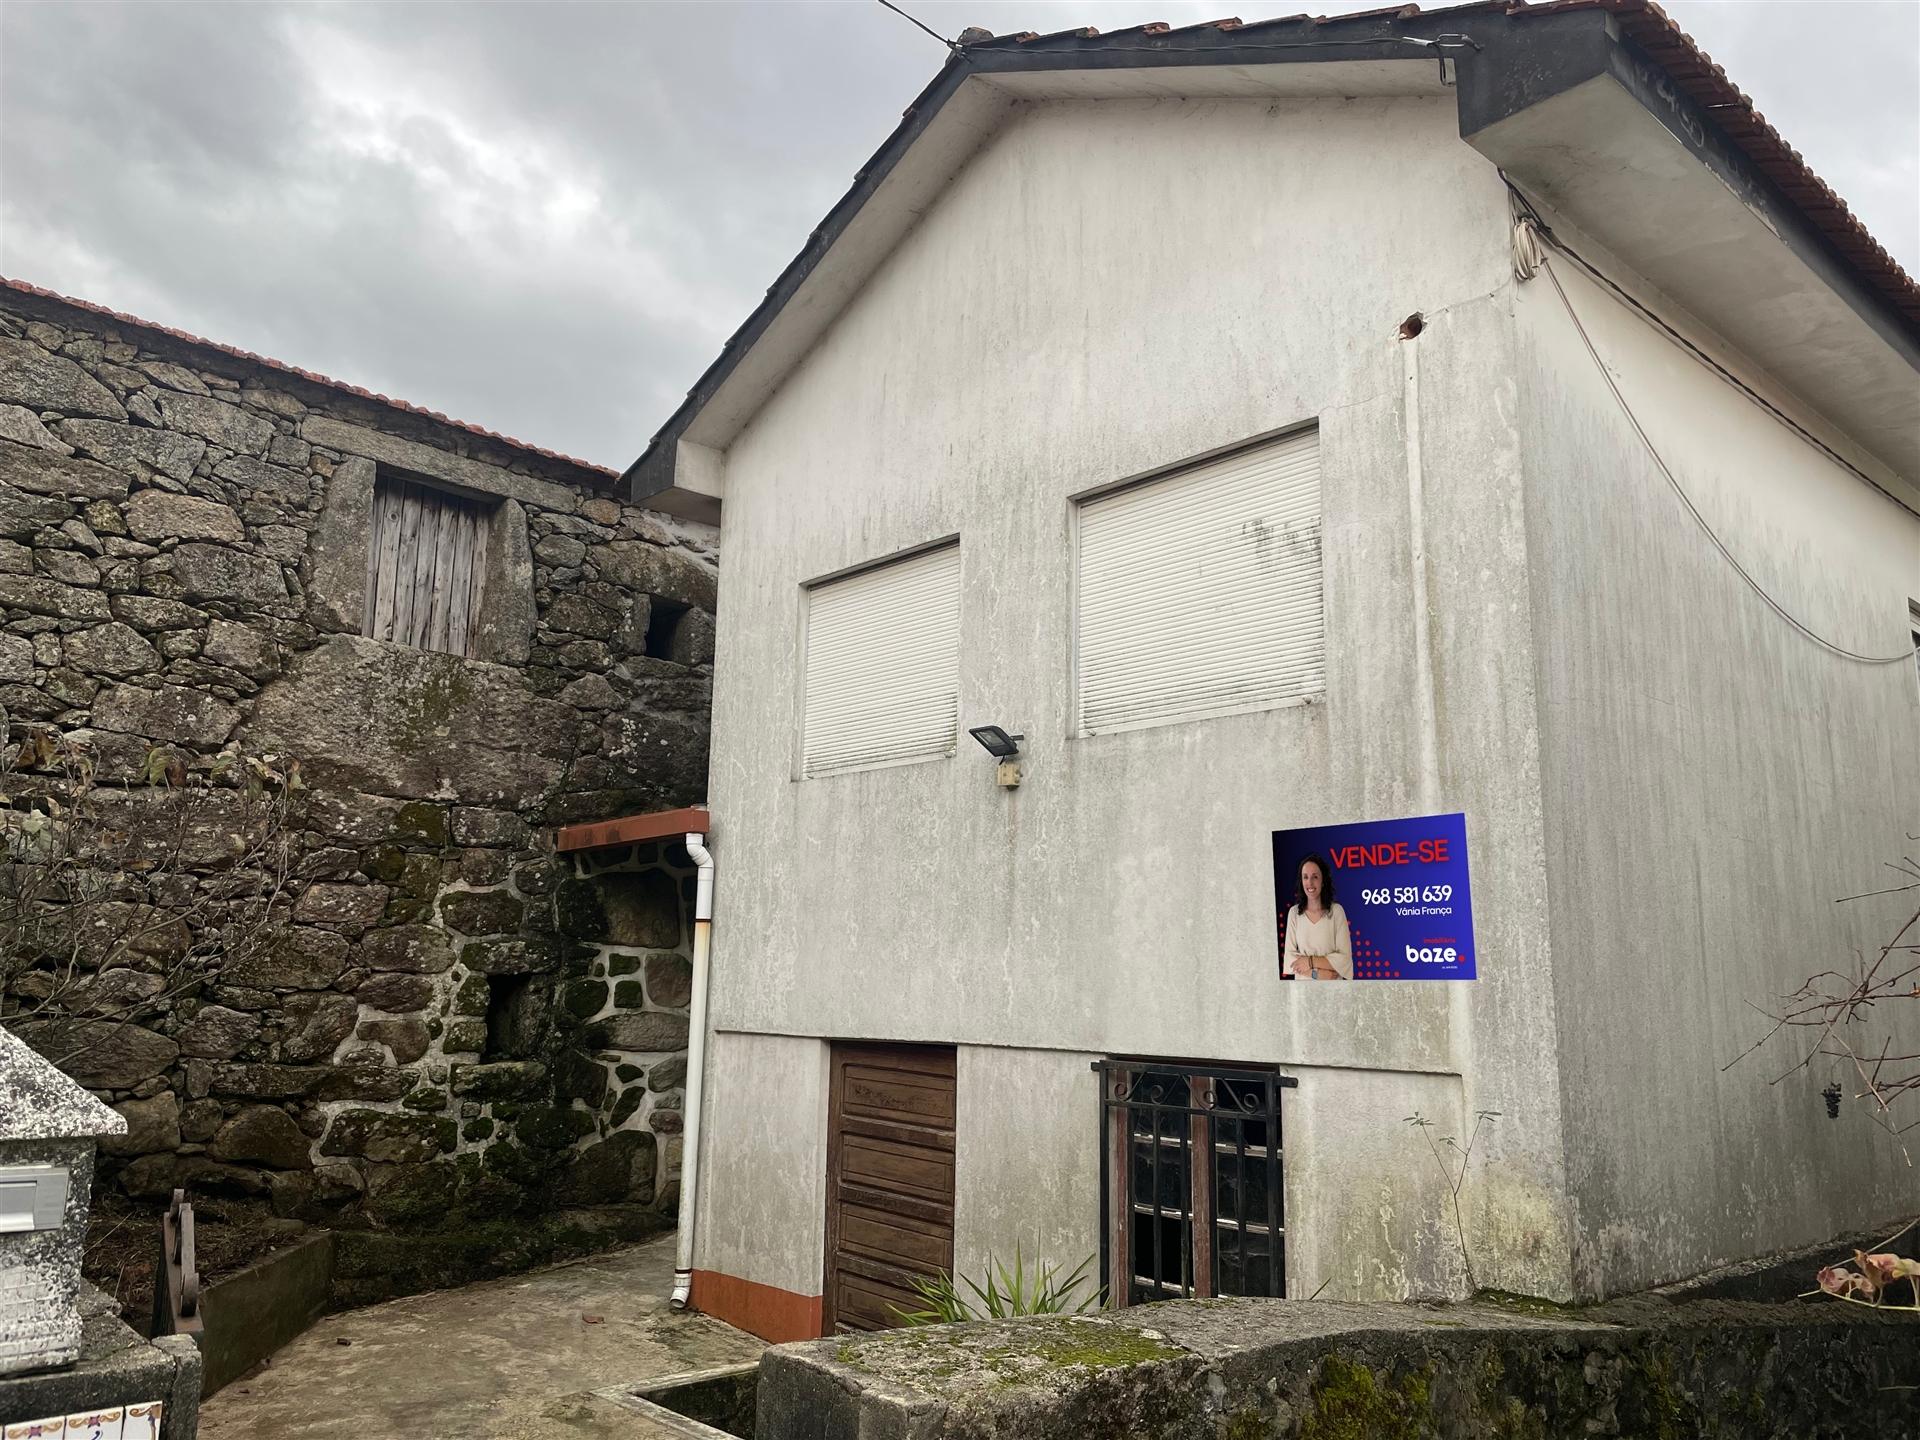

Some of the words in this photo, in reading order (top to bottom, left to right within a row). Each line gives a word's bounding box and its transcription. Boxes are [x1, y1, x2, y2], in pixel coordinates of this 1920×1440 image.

[1329, 839, 1450, 869] VENDE-SE
[1361, 888, 1391, 905] 968
[1393, 886, 1419, 904] 581
[1422, 884, 1453, 903] 639
[1421, 906, 1452, 917] França
